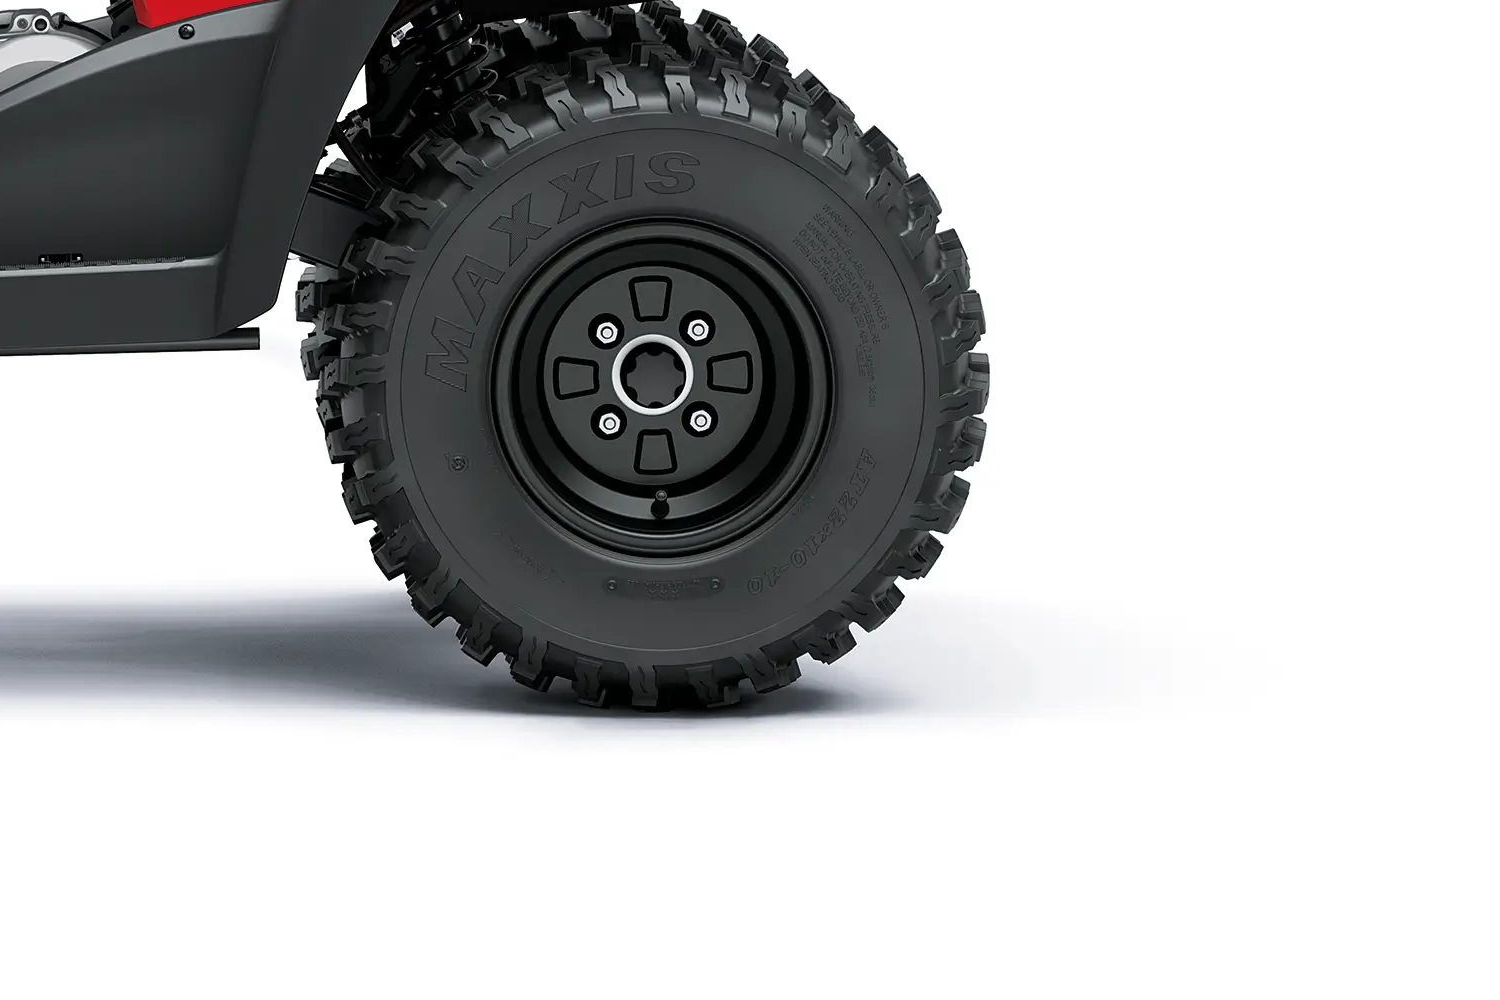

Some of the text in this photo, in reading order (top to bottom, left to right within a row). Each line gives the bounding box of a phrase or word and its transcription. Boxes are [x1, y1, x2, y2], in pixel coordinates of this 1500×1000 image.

[822, 203, 854, 237] WARNING
[424, 150, 701, 392] MAXXIS
[848, 256, 865, 280] LABEL
[829, 283, 845, 304] BEAD
[746, 447, 877, 595] AT22x10-10
